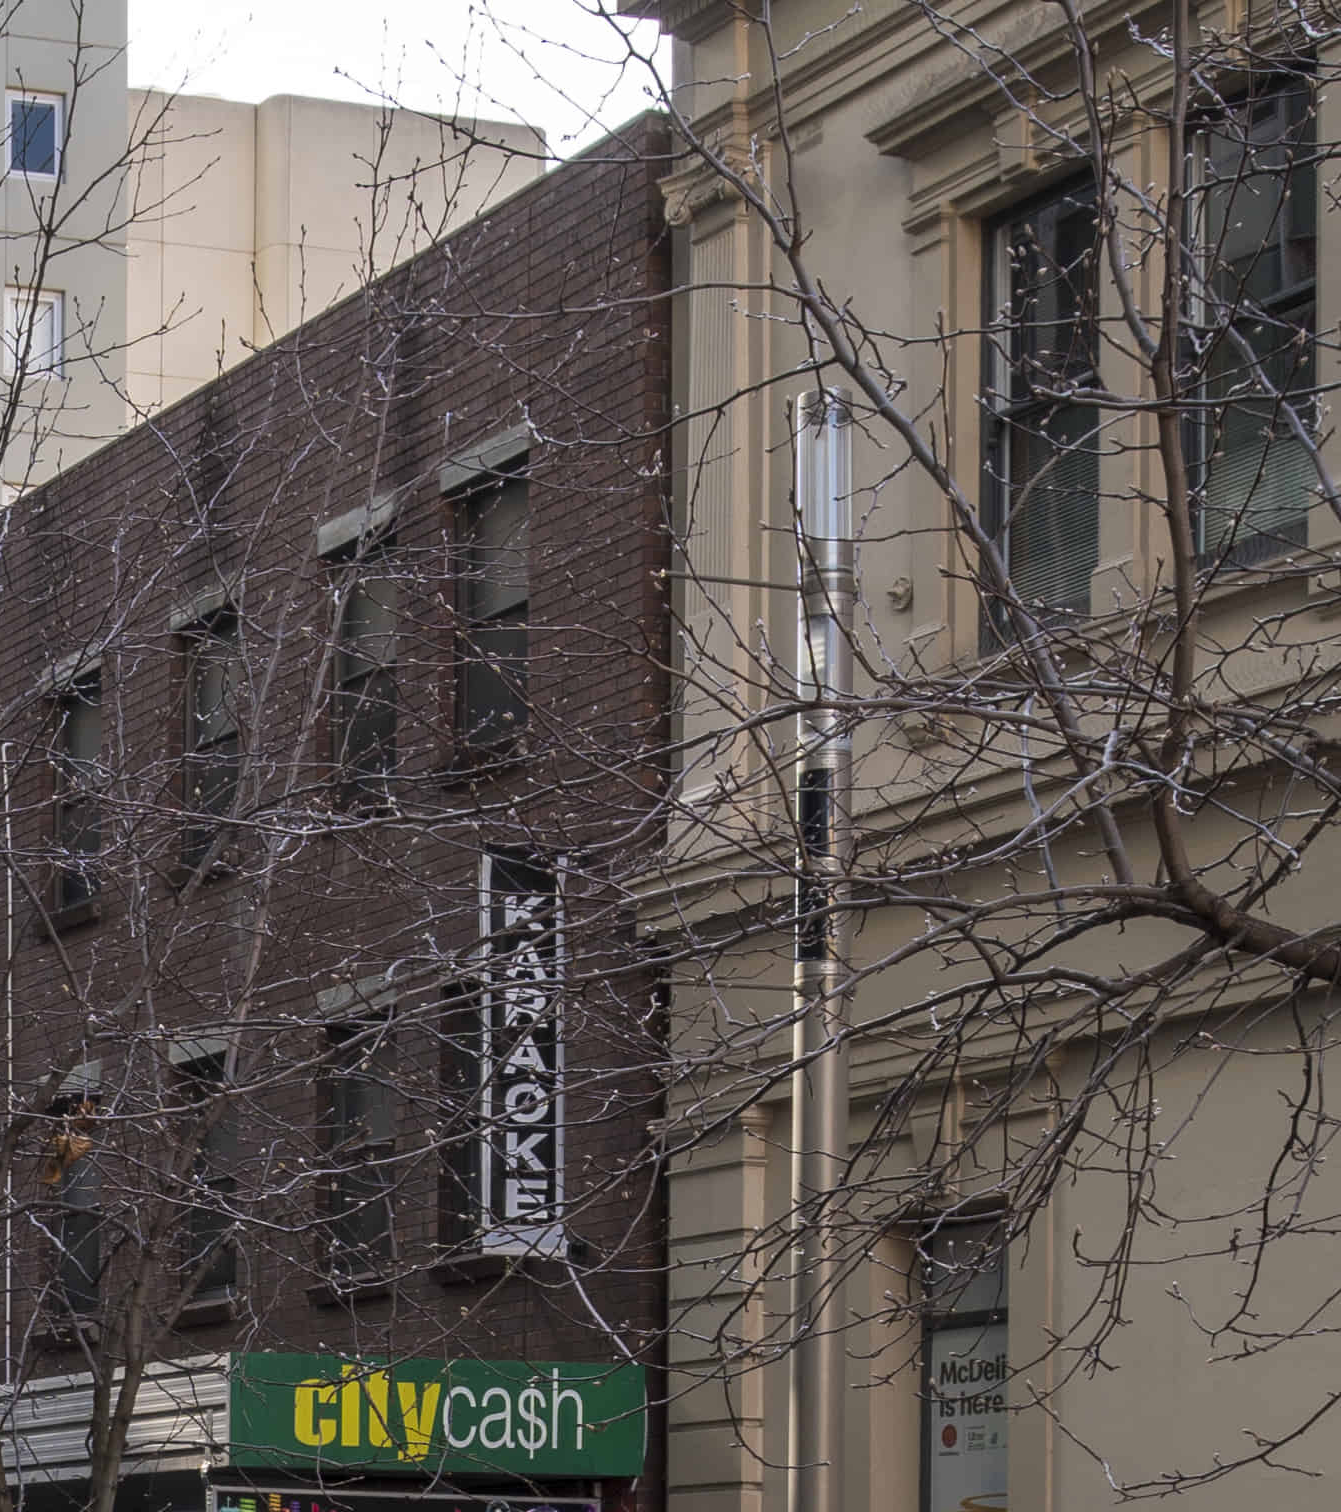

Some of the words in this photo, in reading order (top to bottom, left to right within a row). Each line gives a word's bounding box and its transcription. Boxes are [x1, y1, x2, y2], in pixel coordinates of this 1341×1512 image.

[504, 896, 548, 1221] KARAOKE
[940, 1354, 1006, 1386] McDeli
[940, 1392, 955, 1417] is
